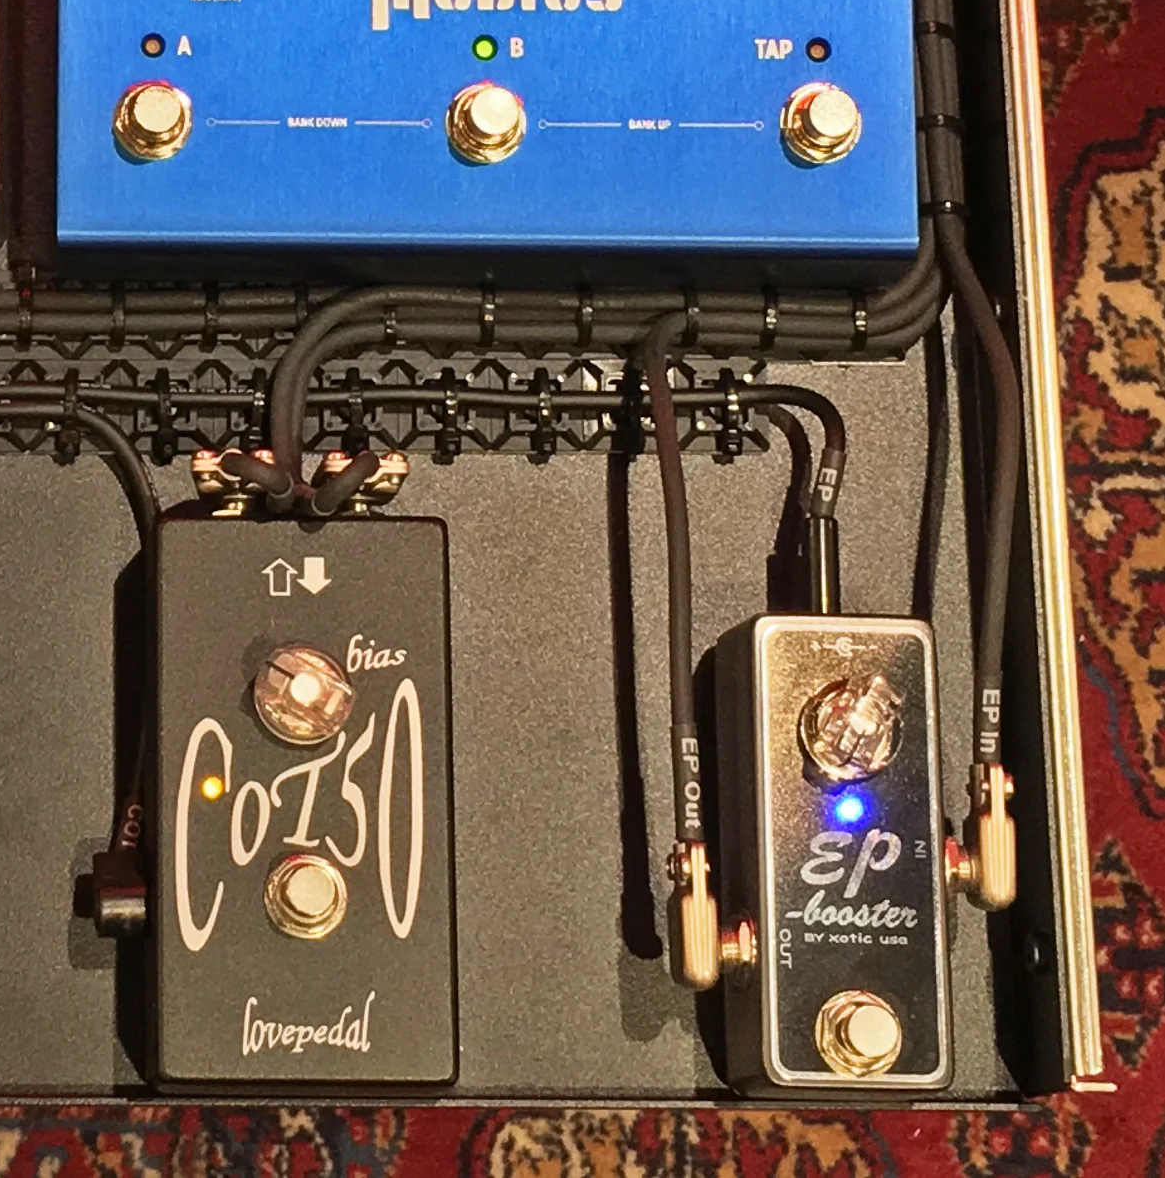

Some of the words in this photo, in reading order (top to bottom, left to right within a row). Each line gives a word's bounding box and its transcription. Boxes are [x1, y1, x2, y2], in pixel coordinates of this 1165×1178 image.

[177, 35, 192, 57] A
[509, 36, 524, 58] B
[754, 38, 793, 60] TAP
[817, 467, 838, 502] EP
[345, 633, 408, 674] bias
[981, 688, 1001, 724] EP
[681, 737, 700, 774] EP
[979, 731, 999, 754] In
[684, 781, 702, 829] Out
[914, 840, 927, 859] IN
[779, 928, 793, 970] OUT
[804, 933, 825, 943] BY
[879, 934, 908, 945] usa
[241, 990, 376, 1057] lovepedal
